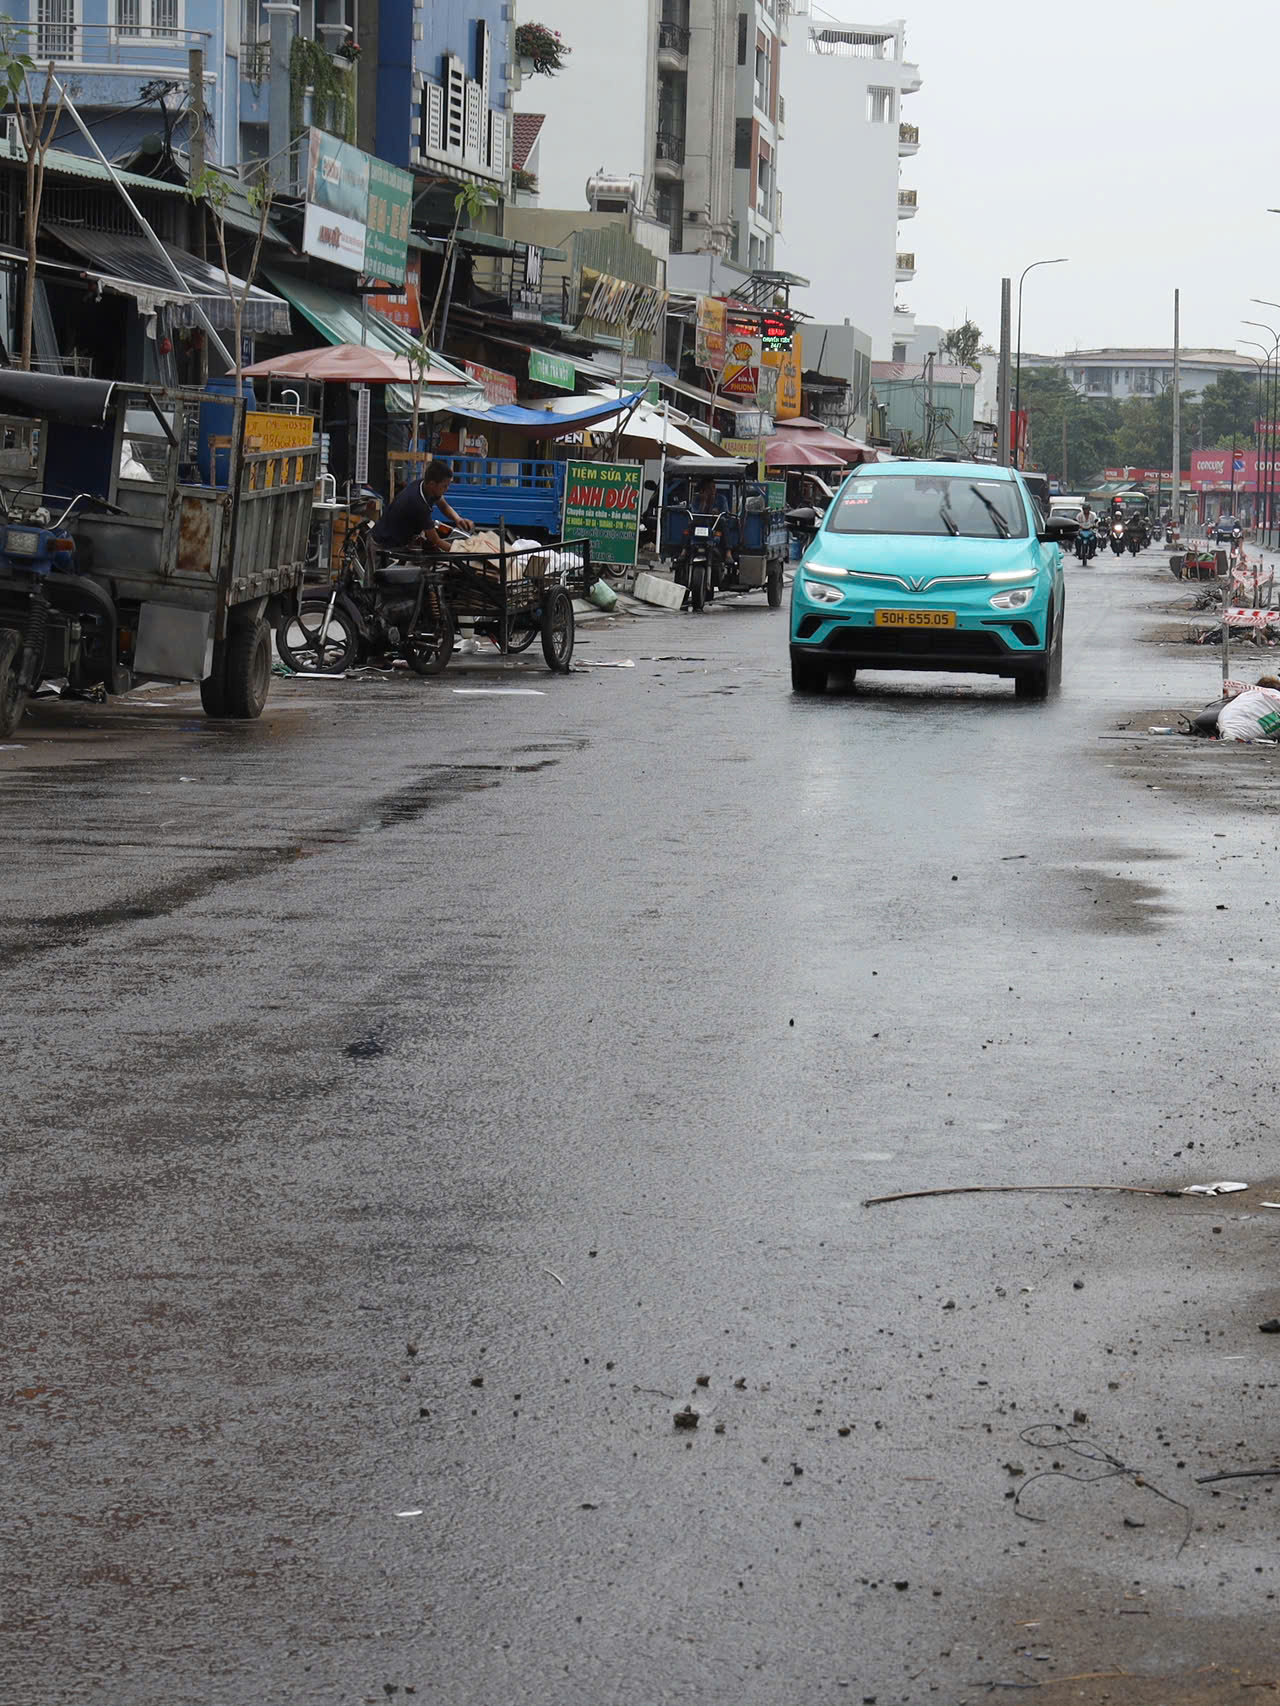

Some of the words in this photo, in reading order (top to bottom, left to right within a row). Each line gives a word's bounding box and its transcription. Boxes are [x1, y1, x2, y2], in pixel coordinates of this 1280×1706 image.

[572, 466, 597, 480] TIỆM
[600, 468, 621, 481] SỬA
[624, 472, 638, 482] XE
[567, 484, 605, 507] ANH
[605, 483, 639, 510] ĐỨC
[881, 612, 949, 625] 50H-655.05
